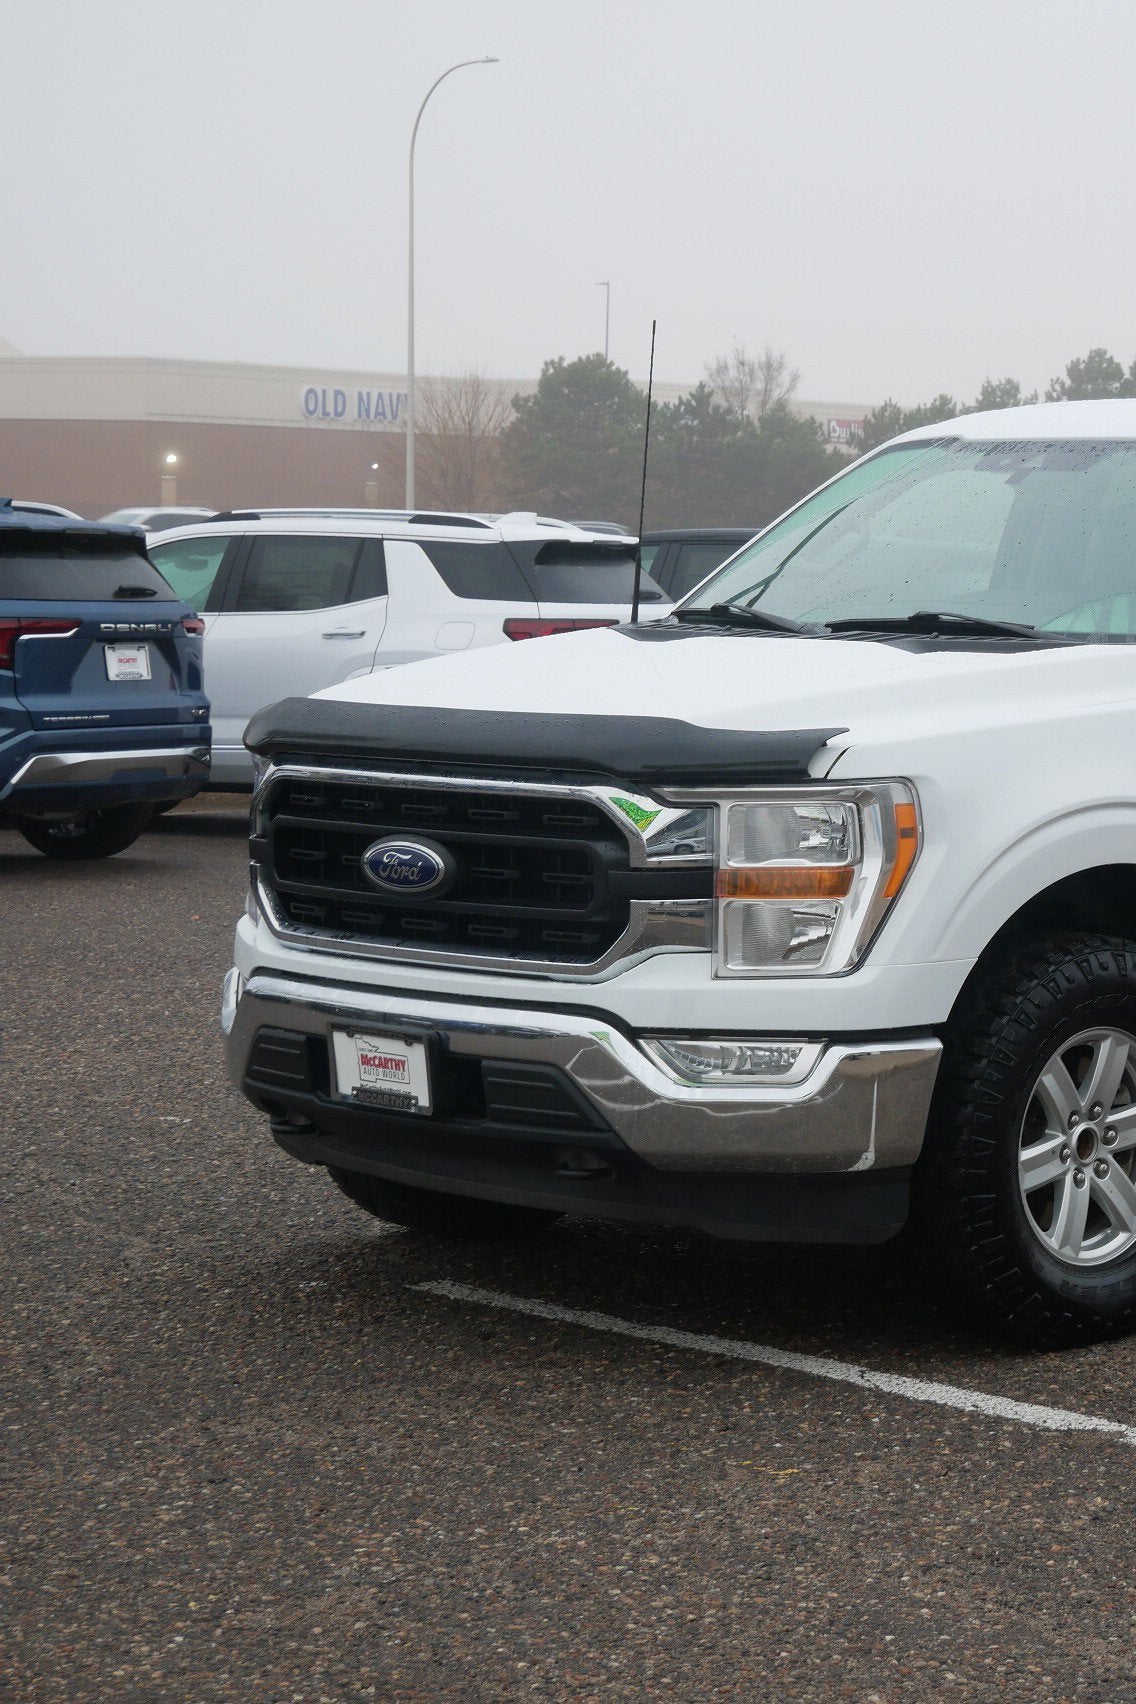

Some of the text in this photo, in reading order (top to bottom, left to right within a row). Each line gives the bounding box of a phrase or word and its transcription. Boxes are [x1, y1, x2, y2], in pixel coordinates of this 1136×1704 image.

[303, 387, 347, 418] OLD
[100, 623, 172, 632] DENALI
[379, 851, 423, 880] Ford
[360, 1053, 406, 1072] McCARTHY
[363, 1067, 406, 1081] AUTO WORLD
